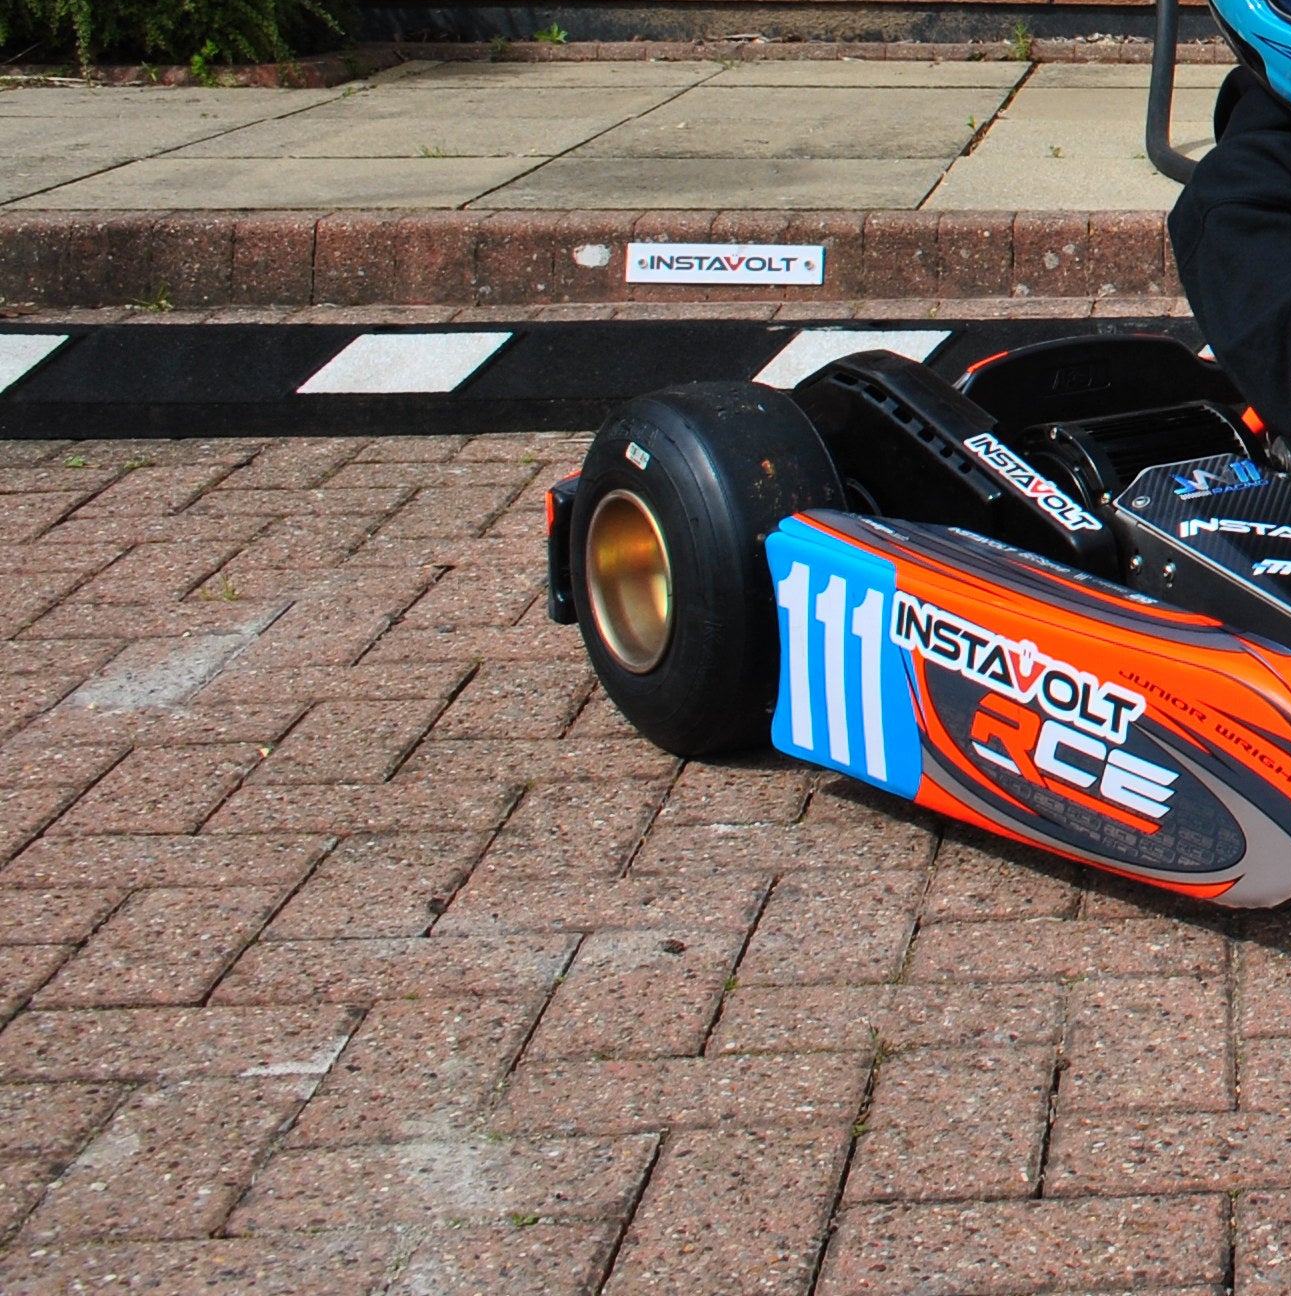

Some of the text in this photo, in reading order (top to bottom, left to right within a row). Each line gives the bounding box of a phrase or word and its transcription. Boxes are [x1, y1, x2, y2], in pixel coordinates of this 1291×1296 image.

[649, 255, 798, 272] INSTAVOLT
[971, 437, 1094, 527] INSTAVOLT
[778, 561, 887, 783] 111
[899, 599, 1142, 738] INSTAVOLT
[1118, 669, 1207, 726] JUNIOR
[970, 692, 1181, 834] RCE
